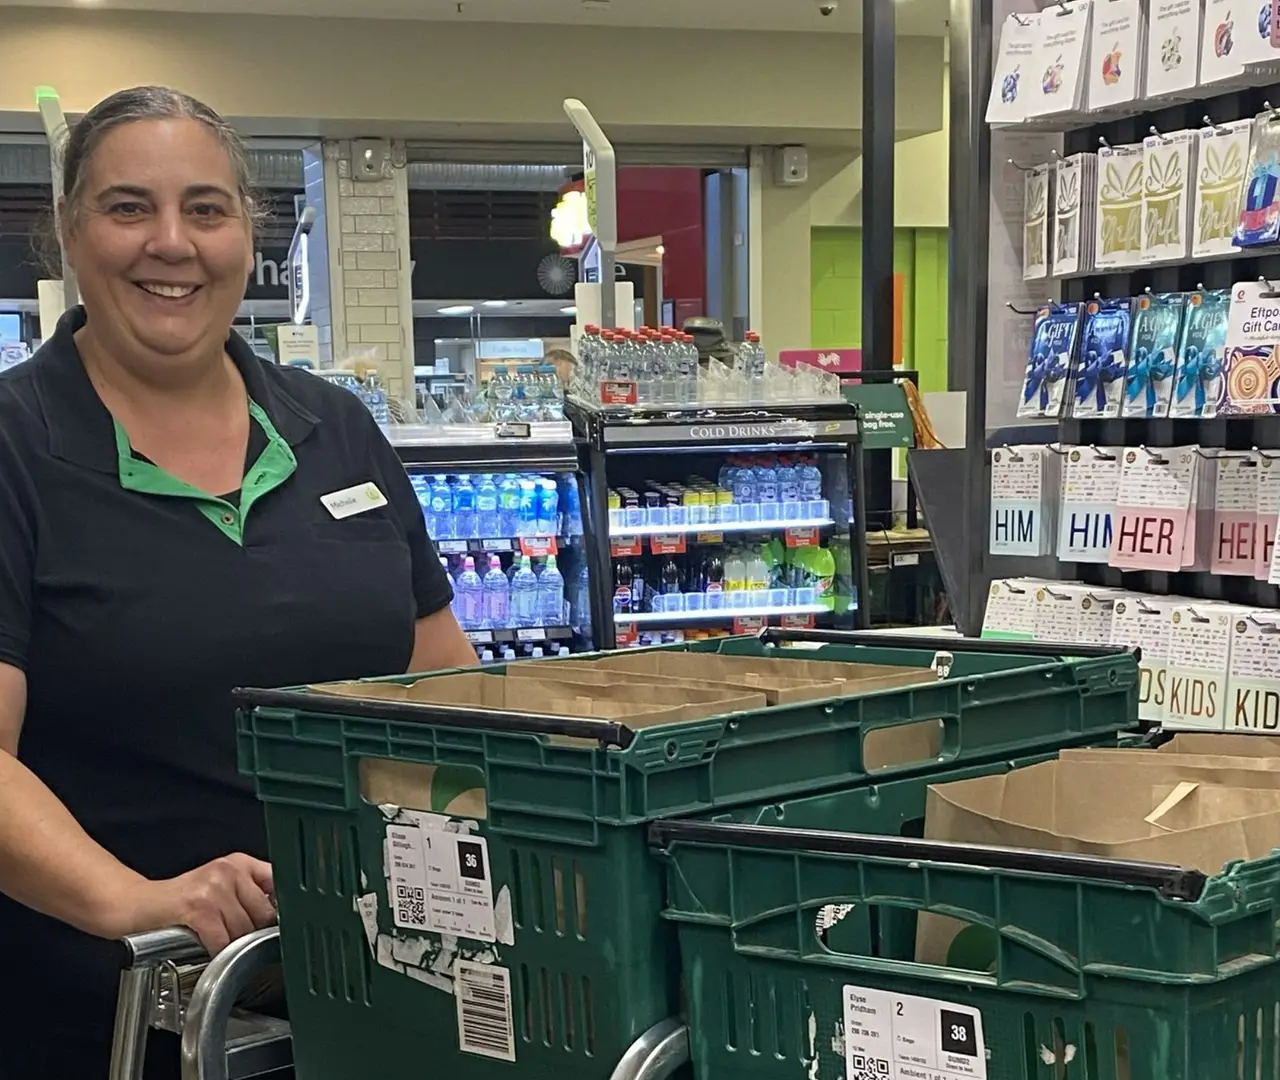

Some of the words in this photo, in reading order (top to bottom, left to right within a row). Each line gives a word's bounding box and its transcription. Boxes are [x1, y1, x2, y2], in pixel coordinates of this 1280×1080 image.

[1242, 321, 1262, 333] Gift
[865, 411, 904, 421] single-use
[690, 426, 725, 438] COLD
[729, 424, 775, 437] DRINKS
[995, 509, 1034, 542] HIM
[1118, 516, 1175, 555] HER
[1170, 676, 1217, 718] KIDS
[465, 853, 477, 868] 36
[951, 1024, 967, 1042] 38
[900, 1067, 927, 1080] Ambient
